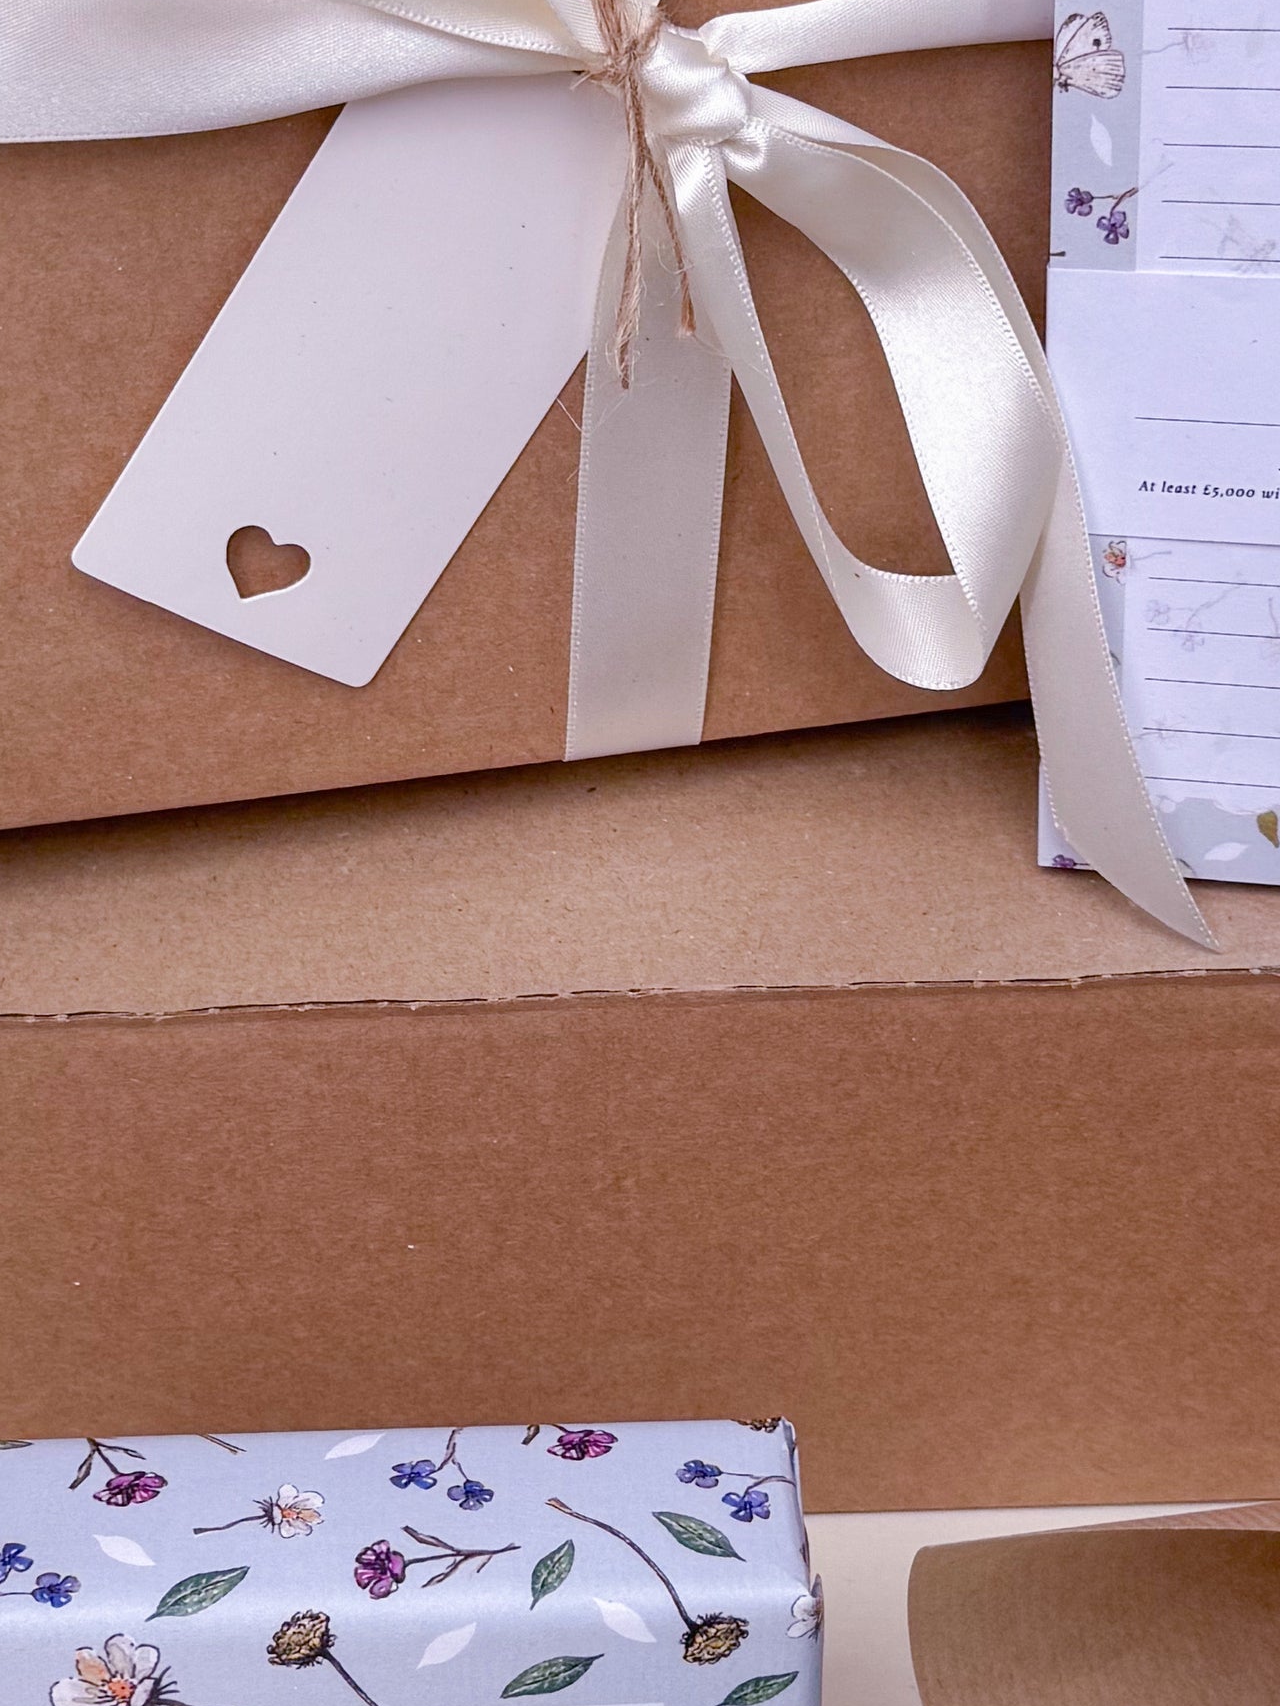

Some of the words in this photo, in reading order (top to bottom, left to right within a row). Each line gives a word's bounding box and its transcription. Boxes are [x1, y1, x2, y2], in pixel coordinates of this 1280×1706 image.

[1138, 480, 1157, 493] At
[1161, 481, 1196, 495] least
[1203, 484, 1255, 499] £5,000
